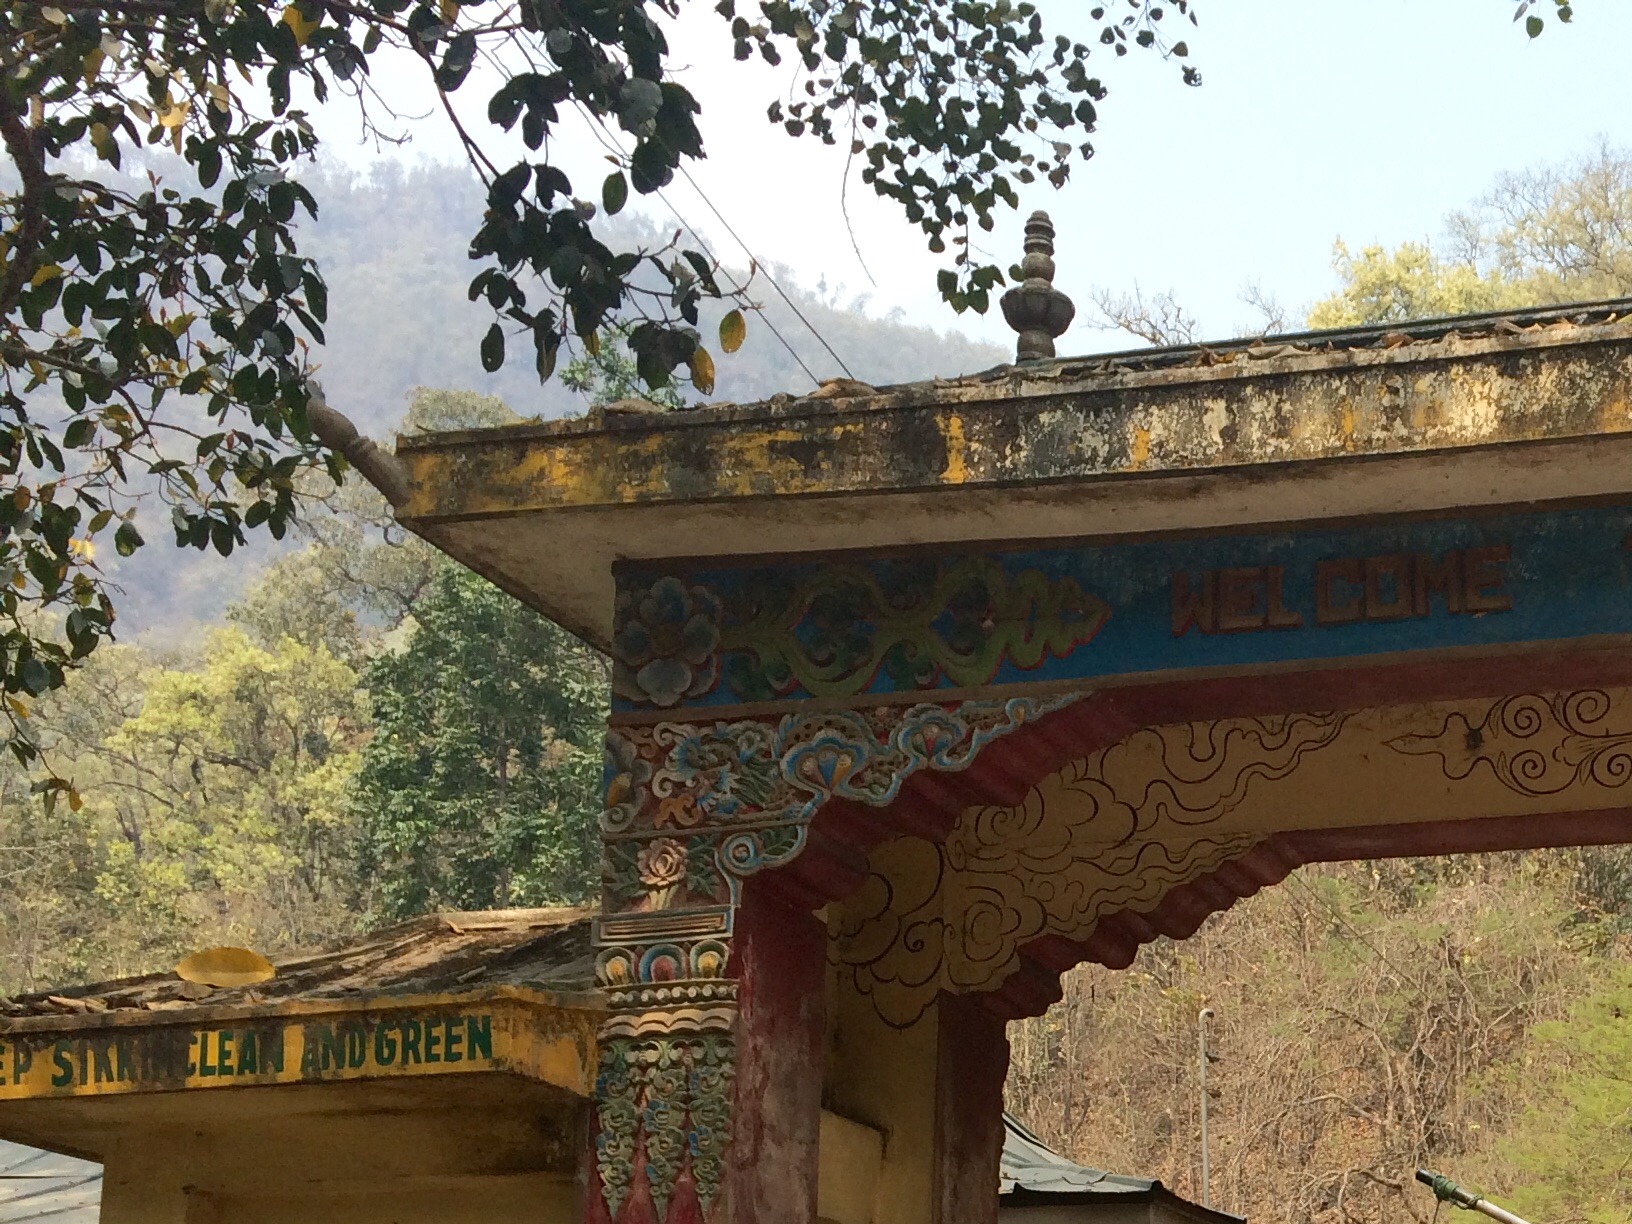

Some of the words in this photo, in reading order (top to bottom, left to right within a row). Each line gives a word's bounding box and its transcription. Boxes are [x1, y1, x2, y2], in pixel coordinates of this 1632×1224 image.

[1171, 543, 1513, 637] WELCOME
[301, 1023, 366, 1073] AND
[374, 1014, 493, 1066] GREEN
